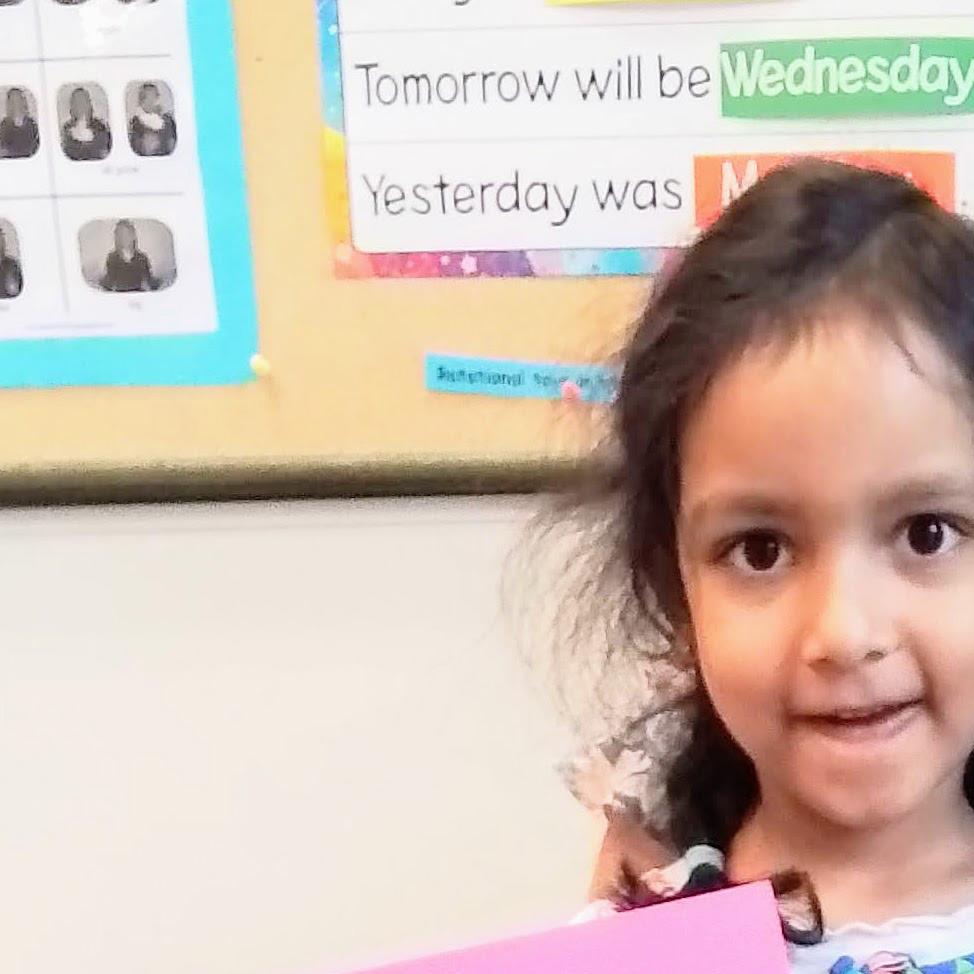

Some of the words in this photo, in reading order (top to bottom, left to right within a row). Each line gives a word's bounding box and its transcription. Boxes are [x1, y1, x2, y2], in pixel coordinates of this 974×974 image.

[355, 63, 560, 106] Tomorrow
[575, 55, 642, 101] will
[657, 54, 711, 99] be
[362, 170, 578, 226] Yesterday
[592, 178, 683, 211] was
